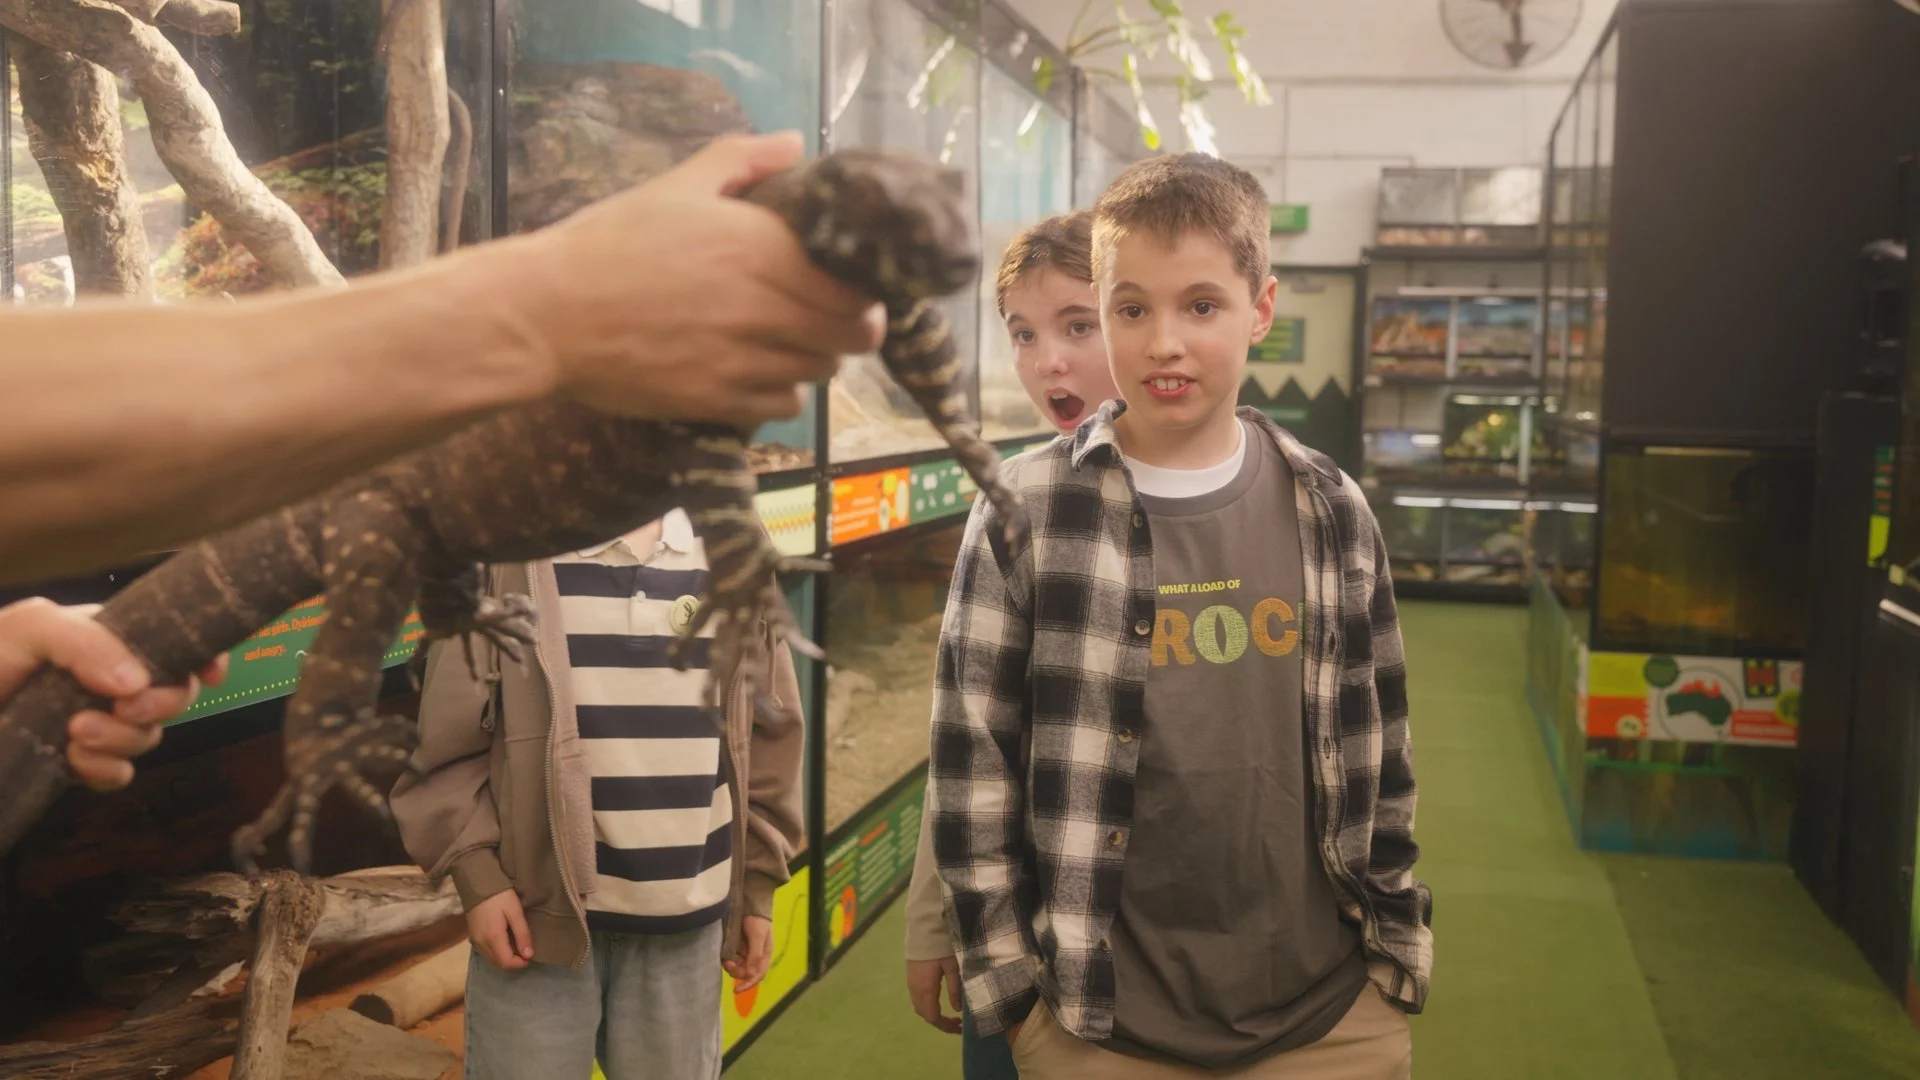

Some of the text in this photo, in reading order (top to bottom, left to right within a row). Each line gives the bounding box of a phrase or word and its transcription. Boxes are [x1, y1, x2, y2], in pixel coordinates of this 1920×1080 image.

[1158, 579, 1241, 595] WHAT A LOAD OF
[1150, 597, 1304, 667] ROC
[244, 646, 261, 661] and
